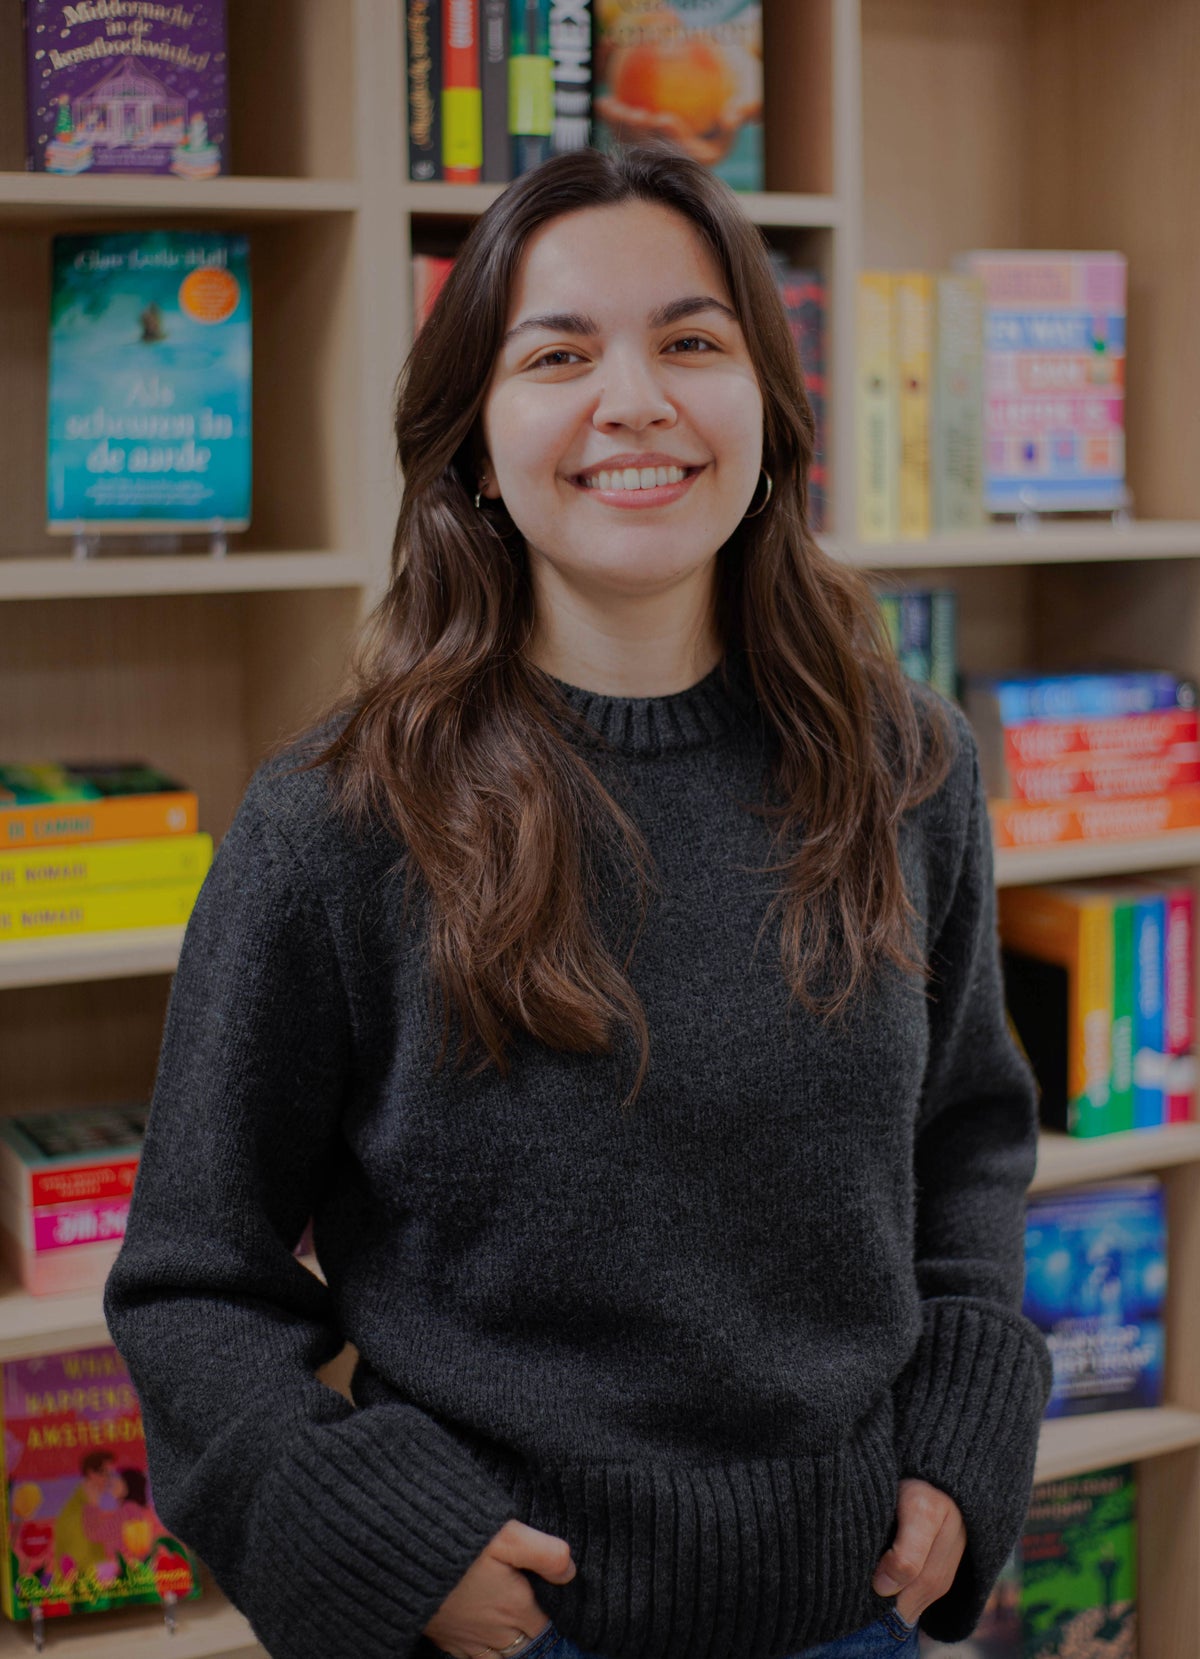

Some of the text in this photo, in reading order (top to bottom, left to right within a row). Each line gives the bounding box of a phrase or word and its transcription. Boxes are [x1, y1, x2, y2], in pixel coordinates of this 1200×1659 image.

[127, 17, 153, 36] de
[200, 405, 234, 441] in
[86, 439, 212, 474] de aarde
